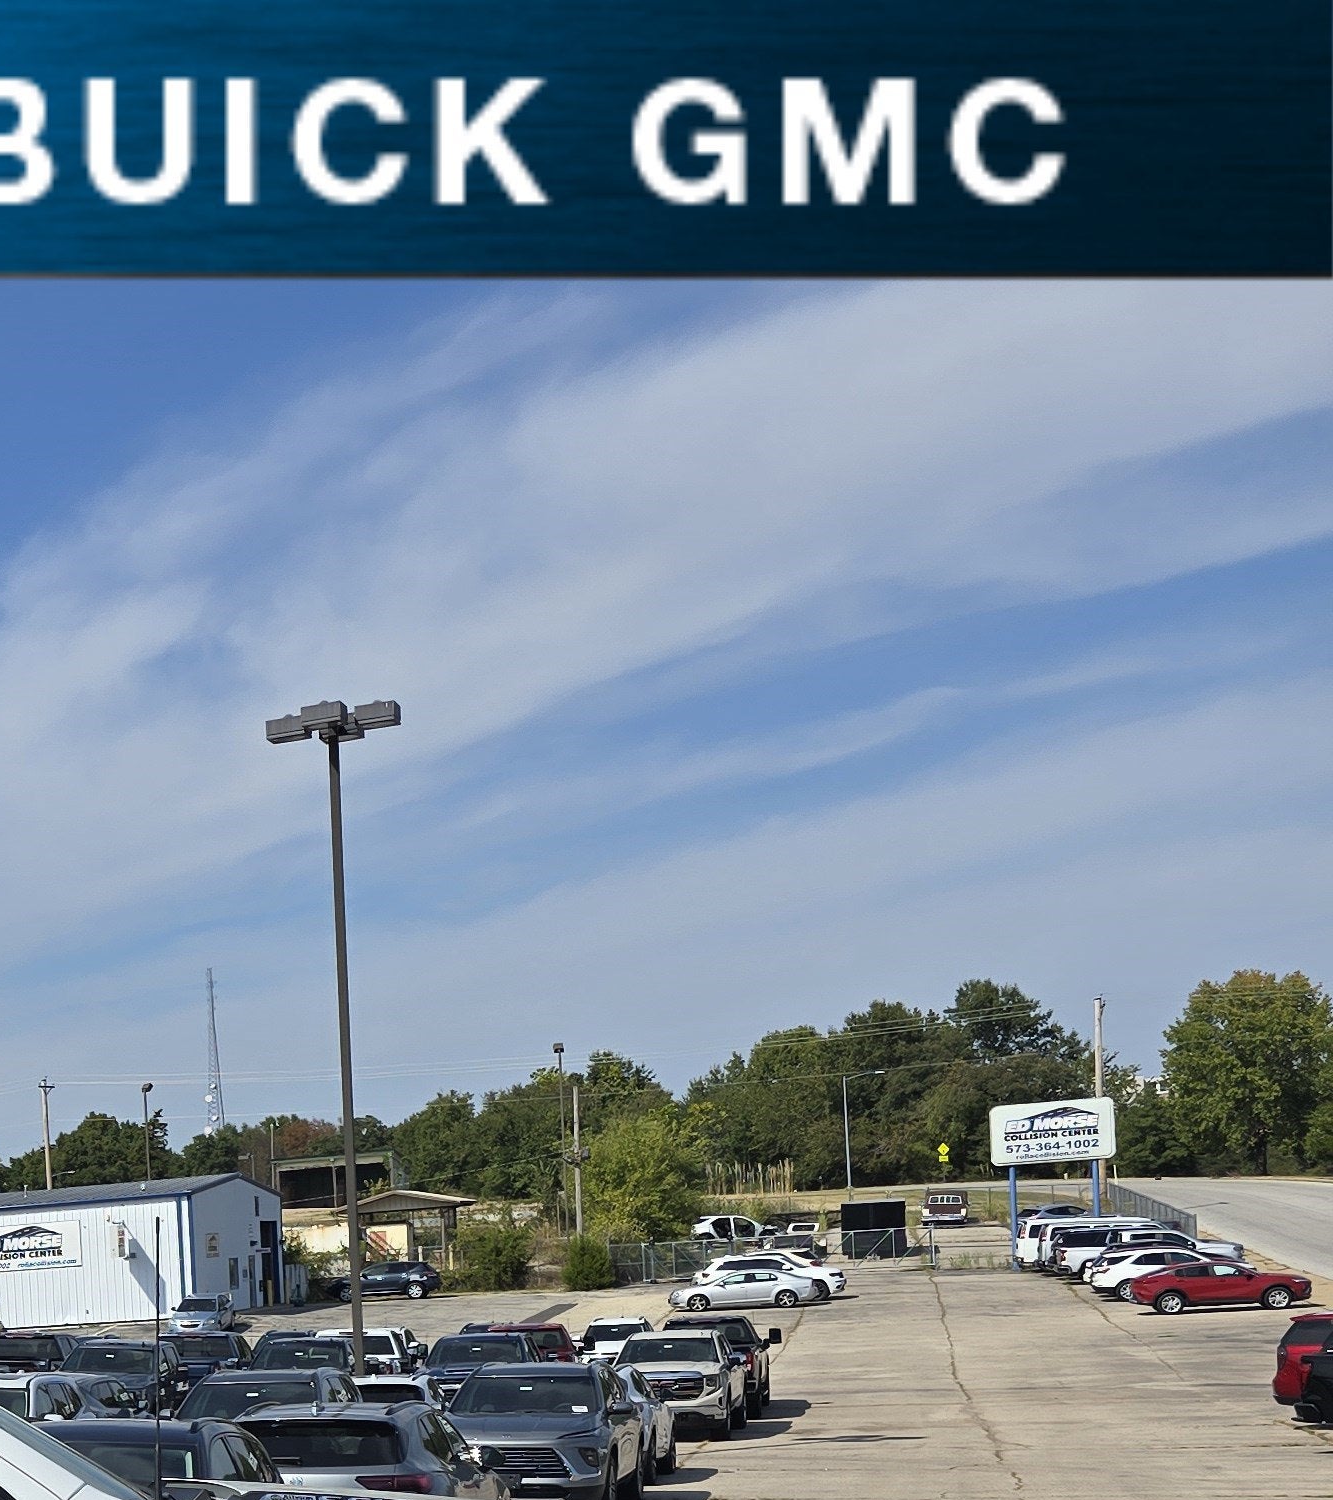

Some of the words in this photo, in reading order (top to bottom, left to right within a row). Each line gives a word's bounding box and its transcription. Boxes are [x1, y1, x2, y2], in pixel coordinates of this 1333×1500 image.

[1005, 1120, 1032, 1134] ED
[1033, 1114, 1099, 1132] MORSE
[1004, 1131, 1058, 1142] COLLISION
[1061, 1128, 1099, 1137] CENTER
[1005, 1139, 1099, 1153] 573-364-1002
[2, 1233, 63, 1252] MORSE
[28, 1249, 63, 1258] CENTER
